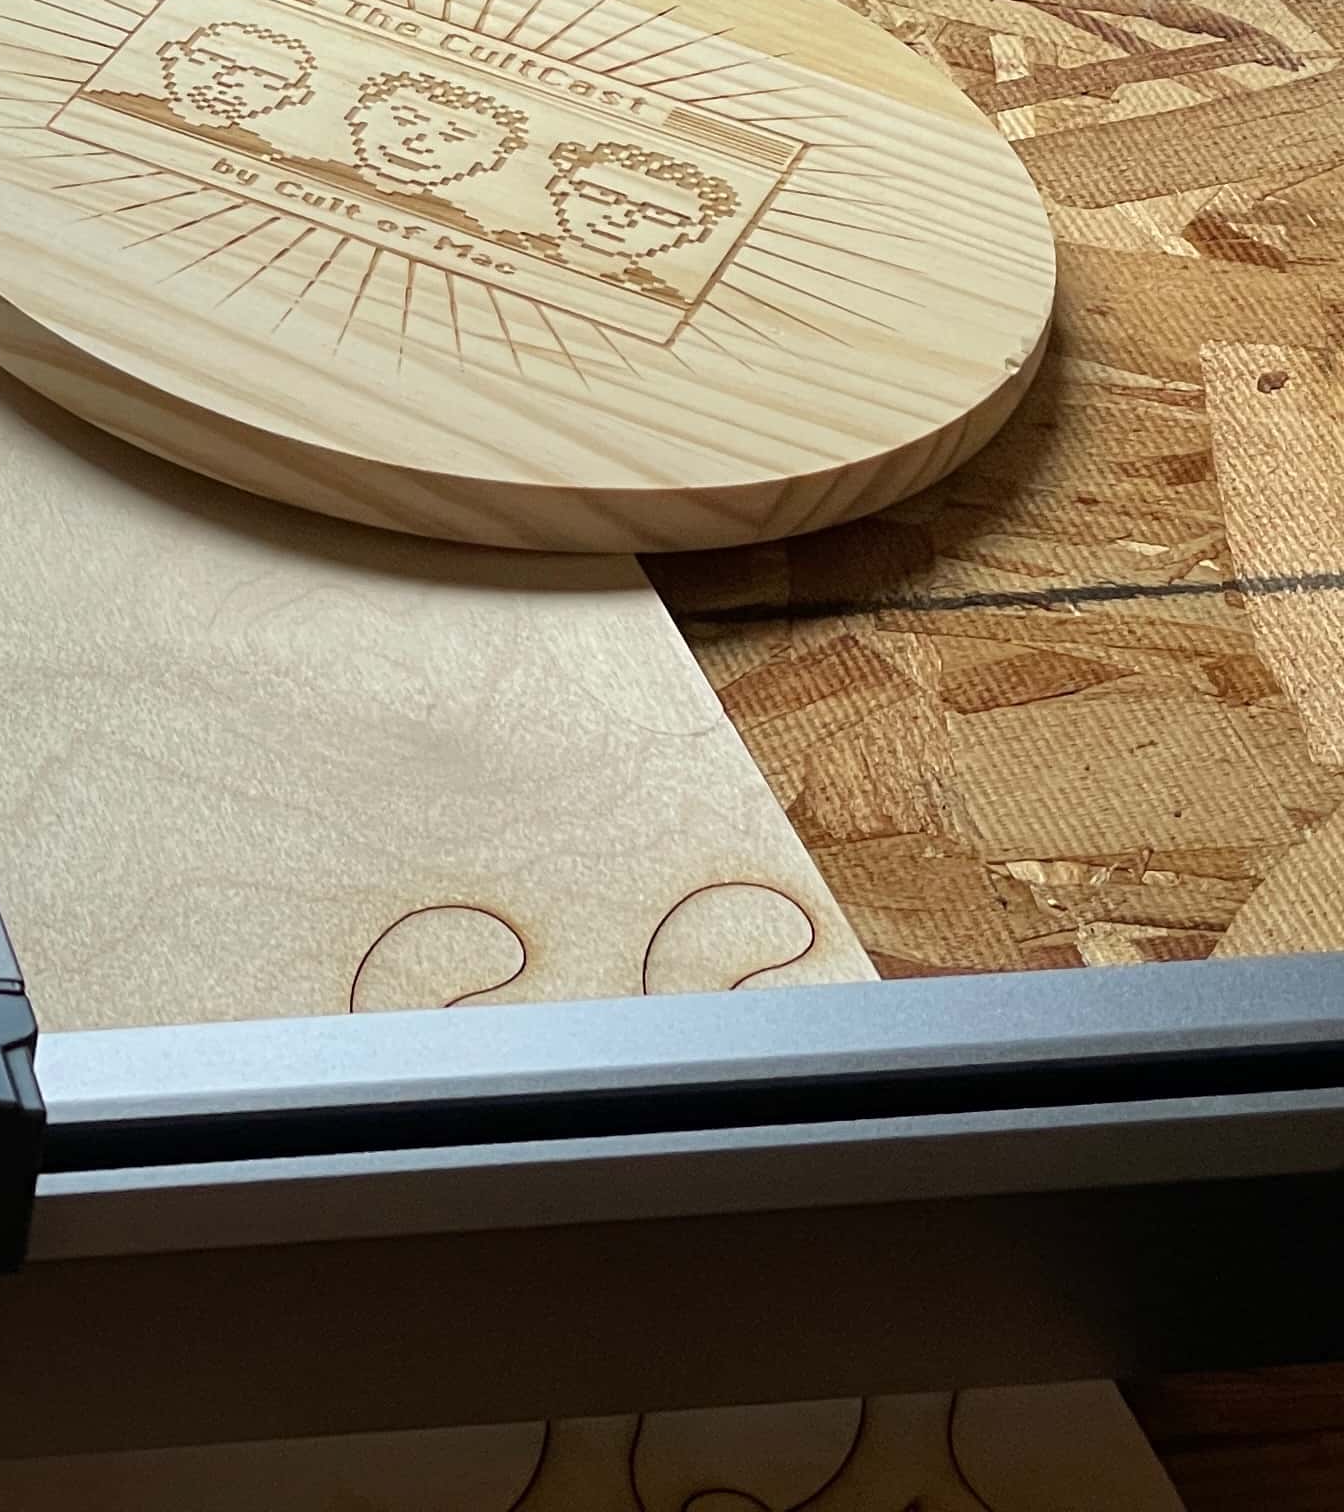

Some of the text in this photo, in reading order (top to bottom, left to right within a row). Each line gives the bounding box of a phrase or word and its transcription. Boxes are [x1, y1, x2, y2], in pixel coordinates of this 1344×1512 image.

[439, 32, 650, 116] CultCast
[212, 157, 518, 275] by Cult of Mac
